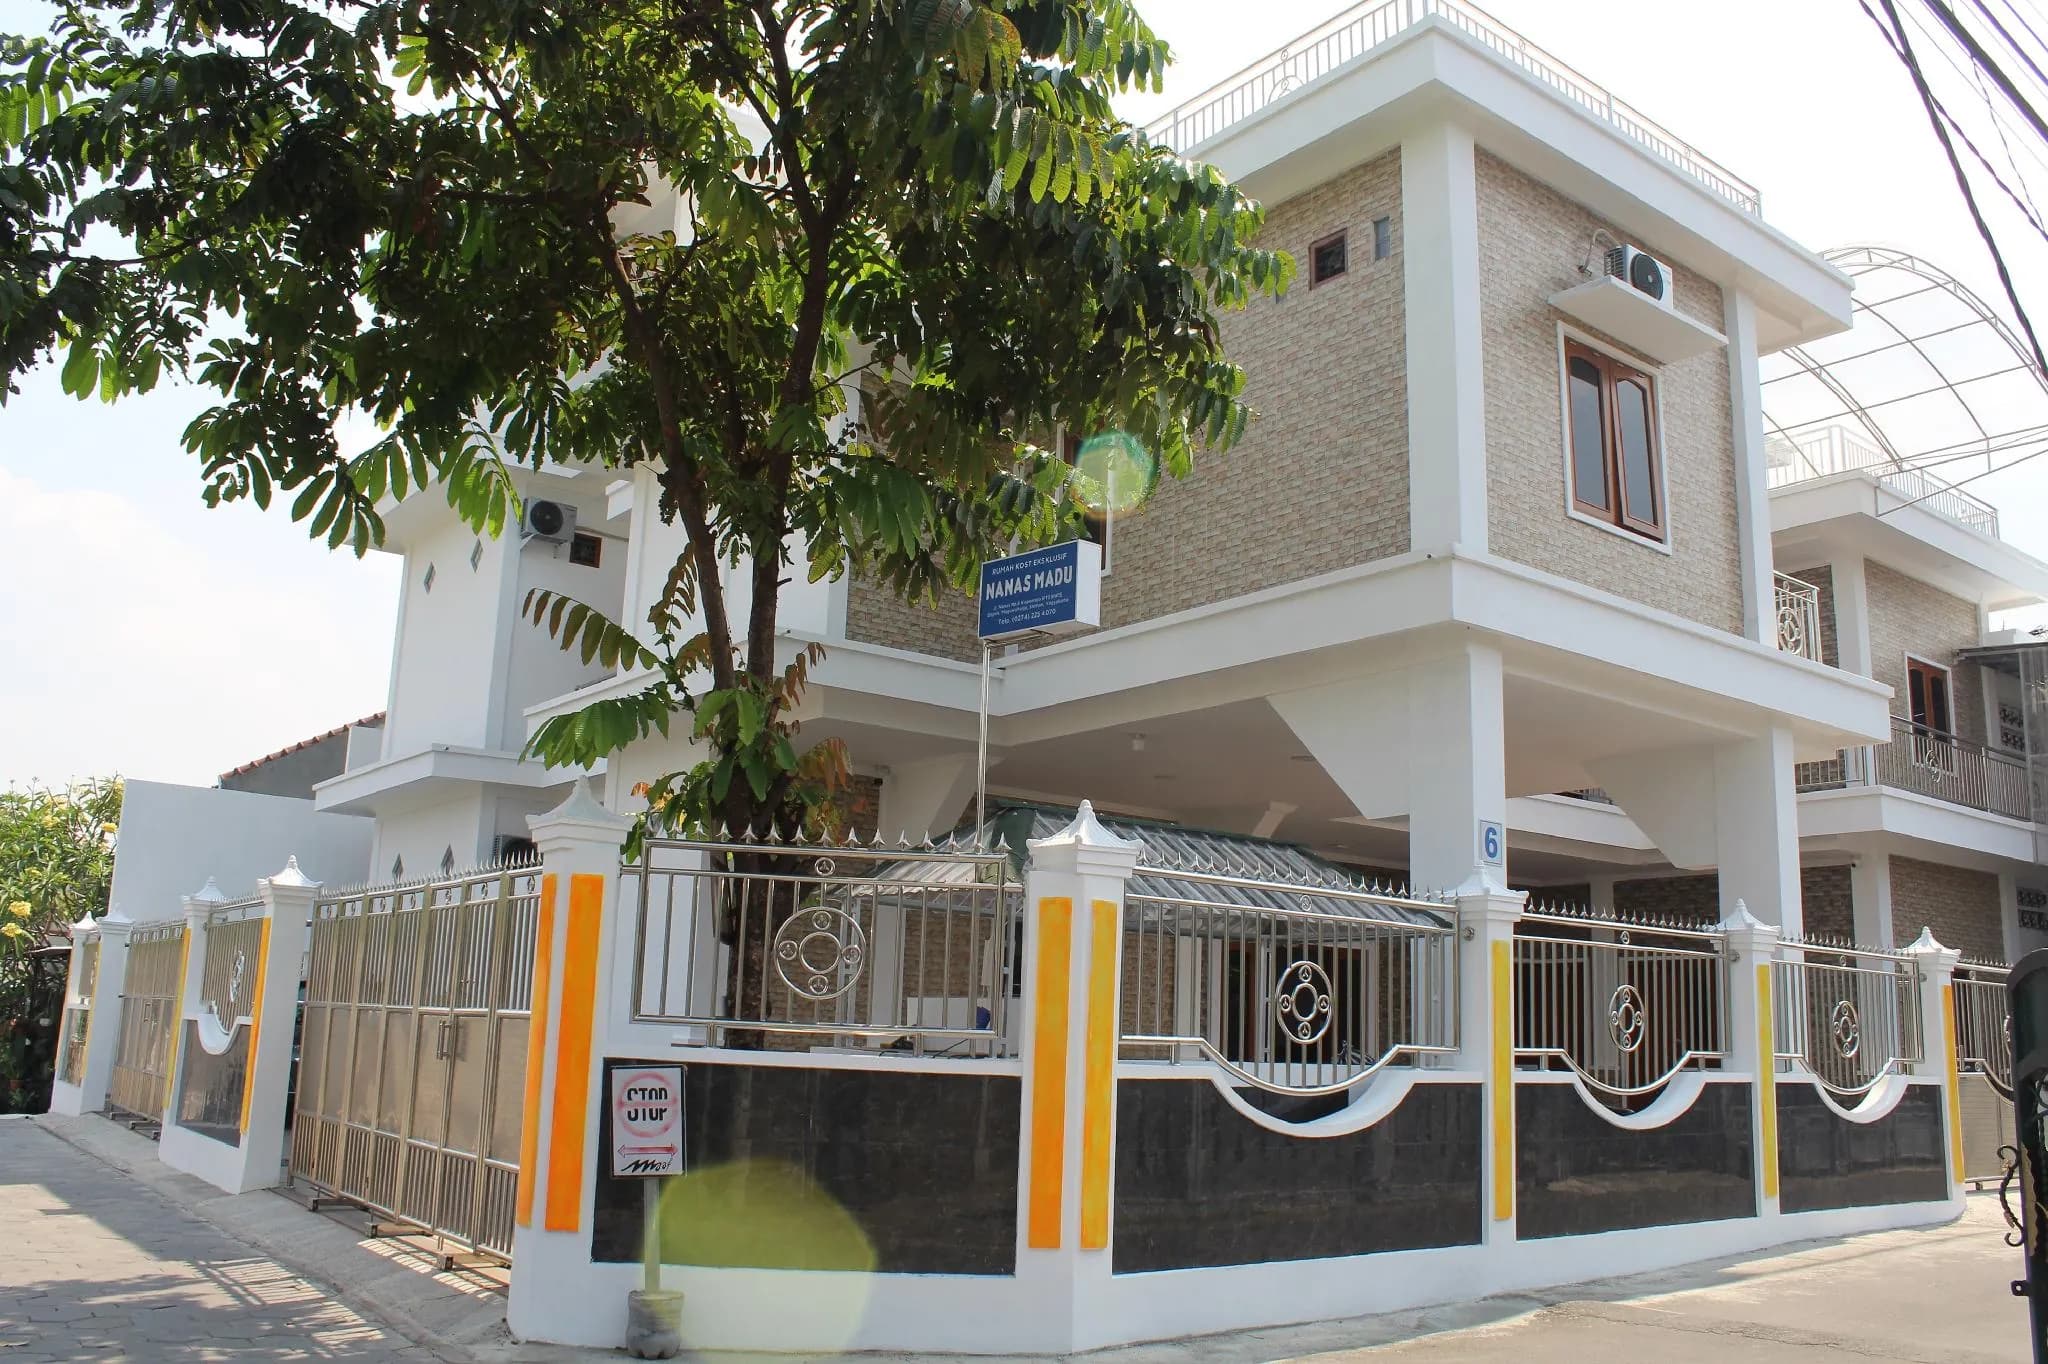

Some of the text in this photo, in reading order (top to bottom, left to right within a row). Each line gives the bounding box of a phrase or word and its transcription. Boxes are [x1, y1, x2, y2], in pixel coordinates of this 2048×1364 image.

[985, 565, 1073, 601] NANAS MADU
[991, 565, 1014, 576] RUMAH
[1015, 560, 1032, 570] KOST
[1484, 826, 1498, 859] 6
